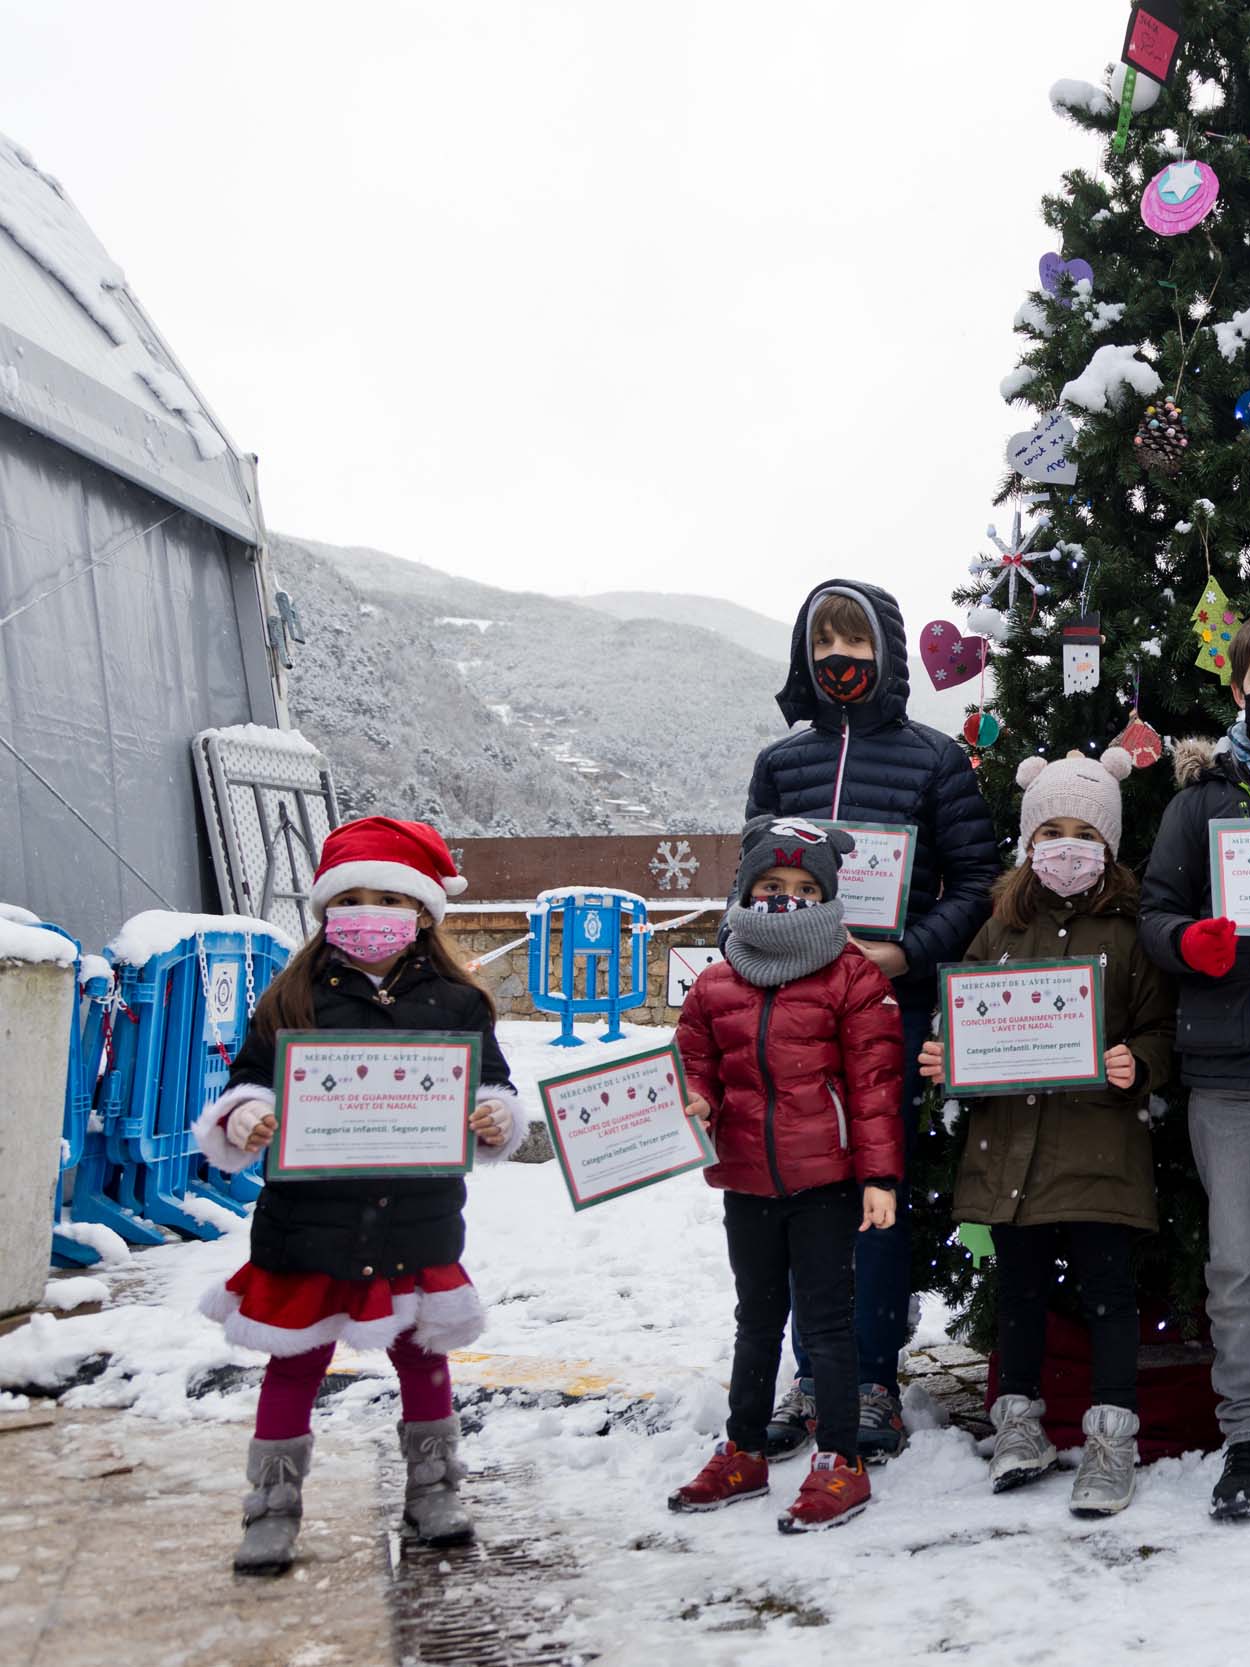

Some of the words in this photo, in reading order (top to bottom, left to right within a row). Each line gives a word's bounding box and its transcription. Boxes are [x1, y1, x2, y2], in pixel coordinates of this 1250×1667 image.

[773, 848, 806, 868] M
[962, 981, 1006, 990] MERCADET
[1021, 978, 1050, 986] L'AVET
[961, 1018, 996, 1026] CONCURS
[1009, 1014, 1062, 1024] GUARNIMENTS
[967, 1046, 1002, 1055] Categoria
[1059, 1042, 1080, 1050] premi
[604, 1079, 614, 1088] DE
[305, 1126, 350, 1135] Categoria
[392, 1125, 418, 1134] Segon
[421, 1125, 447, 1134] premi
[568, 1124, 601, 1139] CONCURS
[602, 1120, 611, 1128] DE
[612, 1107, 657, 1125] GUARNIMENTS
[598, 1126, 620, 1138] L'AVET
[620, 1124, 629, 1132] DE
[630, 1118, 652, 1128] NADAL
[582, 1152, 613, 1167] Categoria
[639, 1136, 659, 1148] Tercer
[828, 1478, 846, 1493] N
